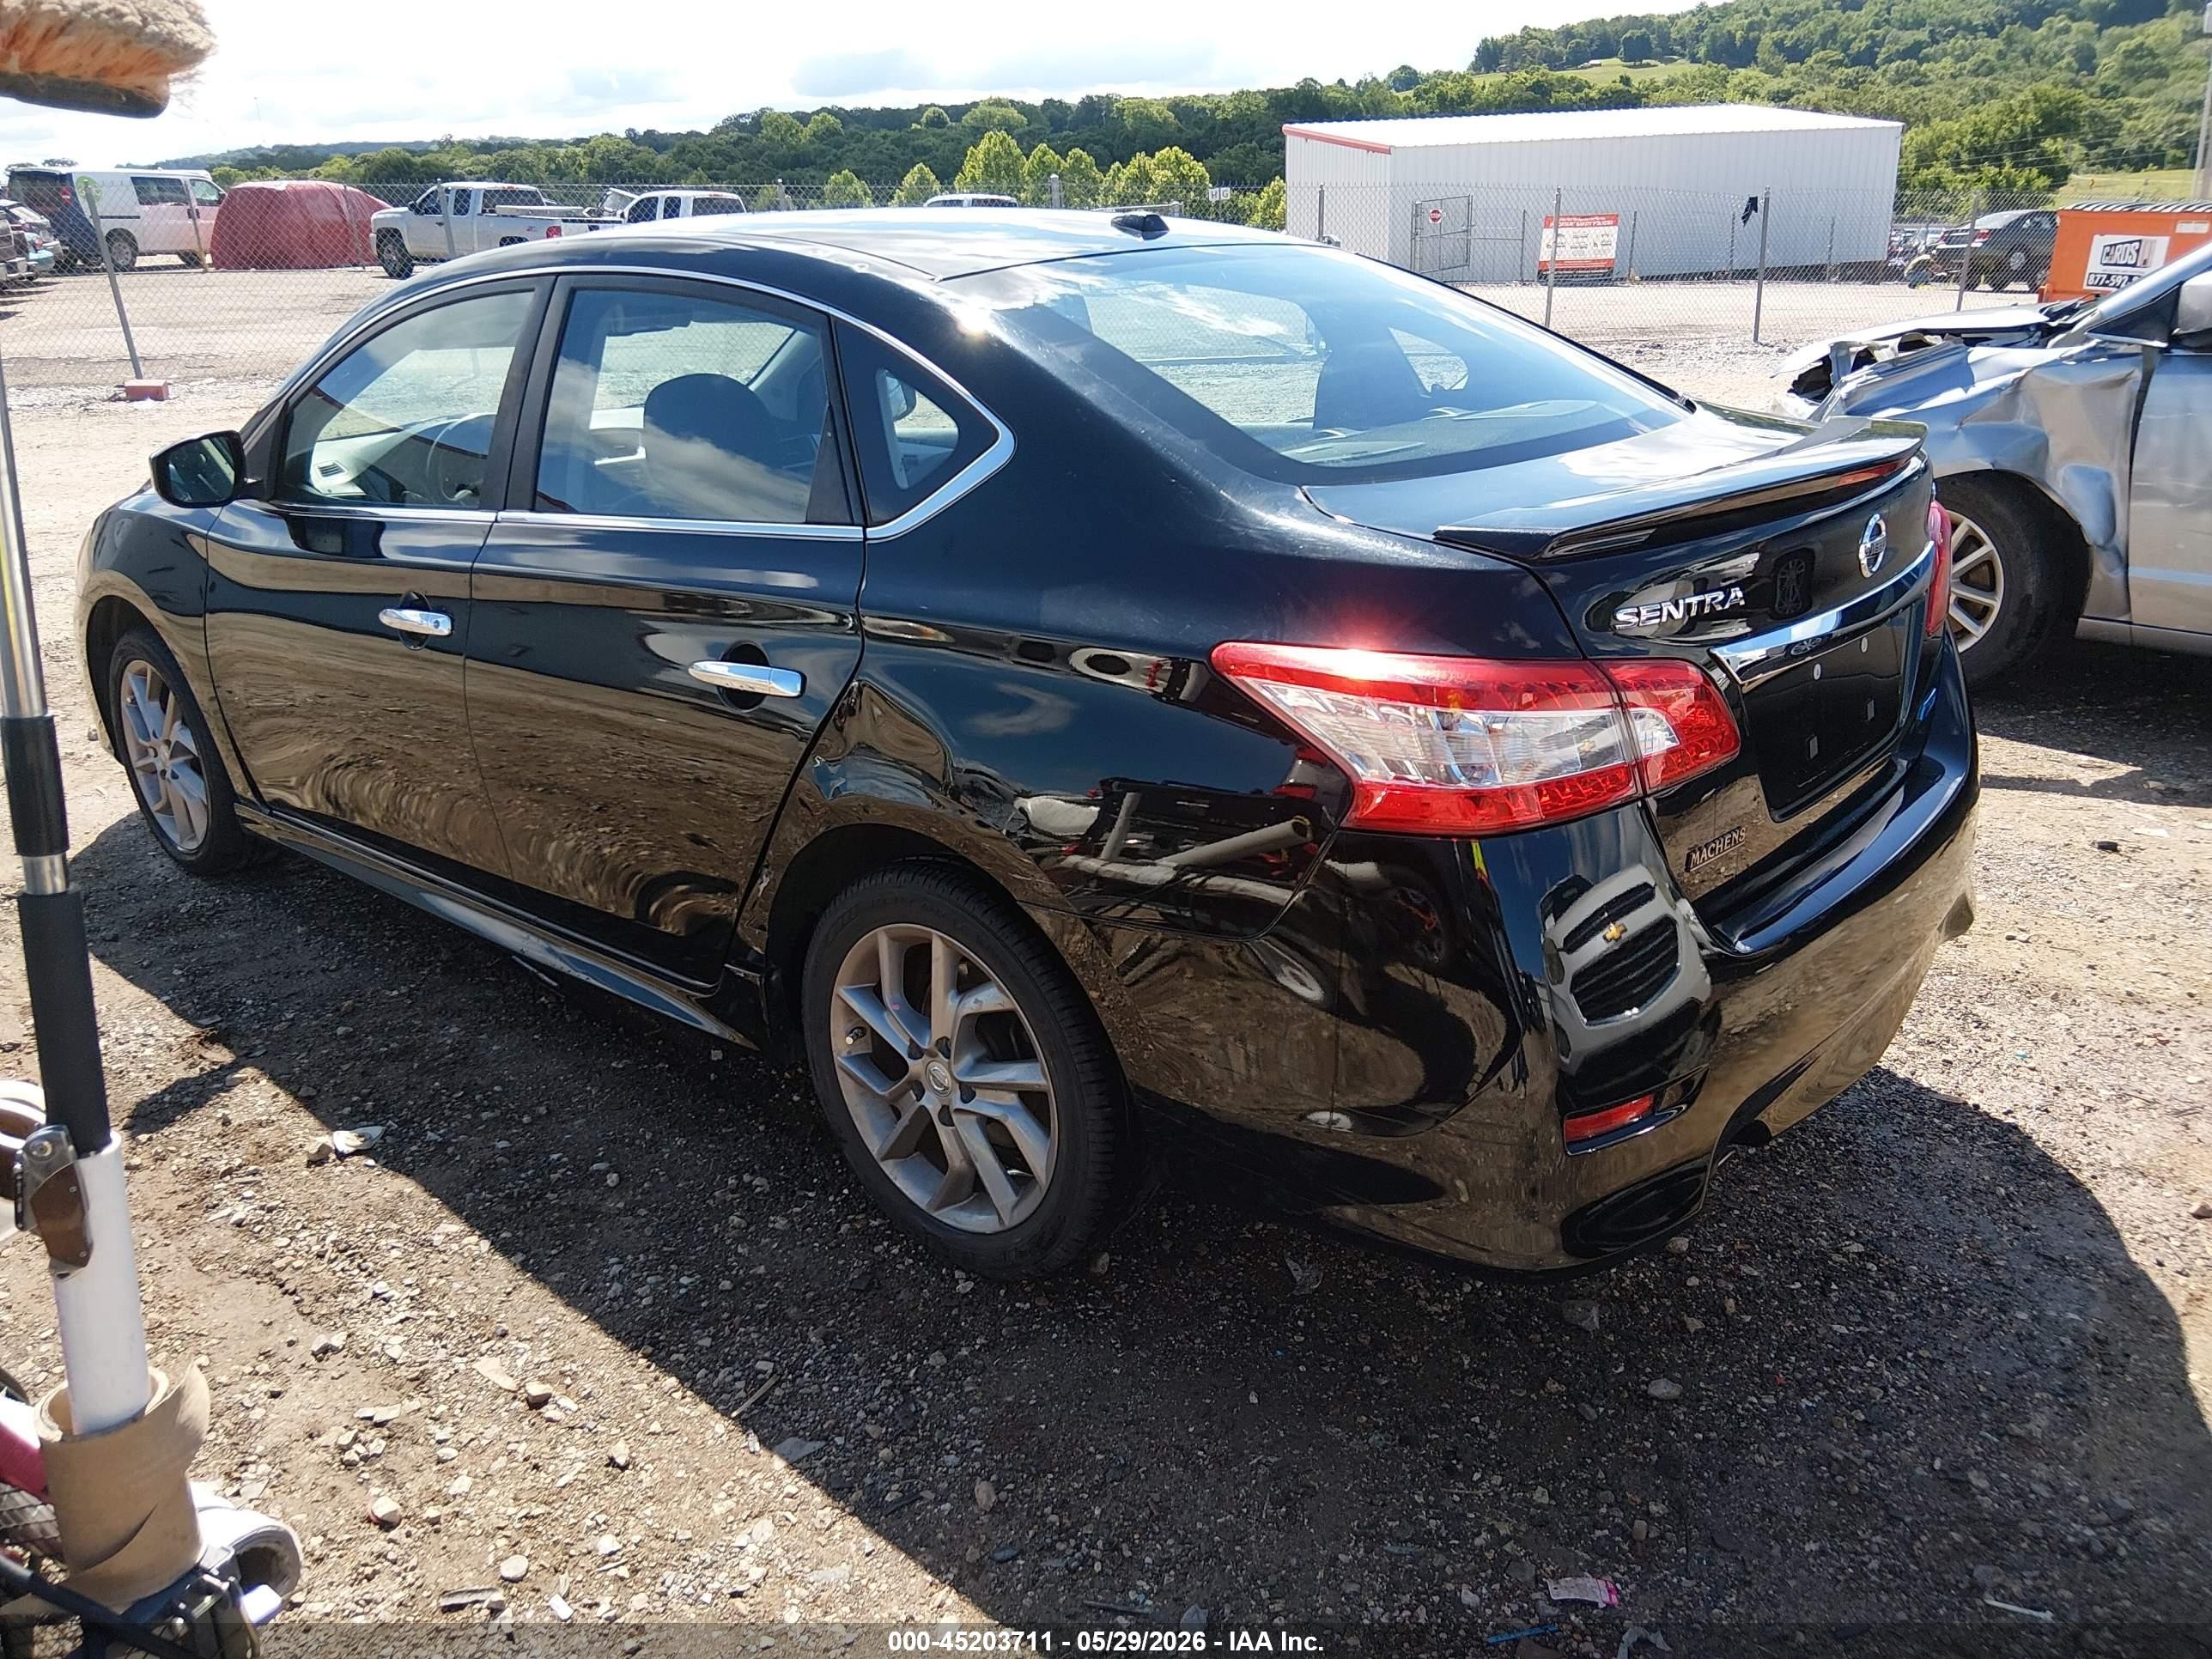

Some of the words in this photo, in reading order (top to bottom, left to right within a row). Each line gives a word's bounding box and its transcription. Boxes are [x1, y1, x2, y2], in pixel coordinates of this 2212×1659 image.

[2101, 241, 2140, 264] CARDS
[1615, 586, 1746, 630] SENTRA
[1689, 826, 1747, 869] MACHENS
